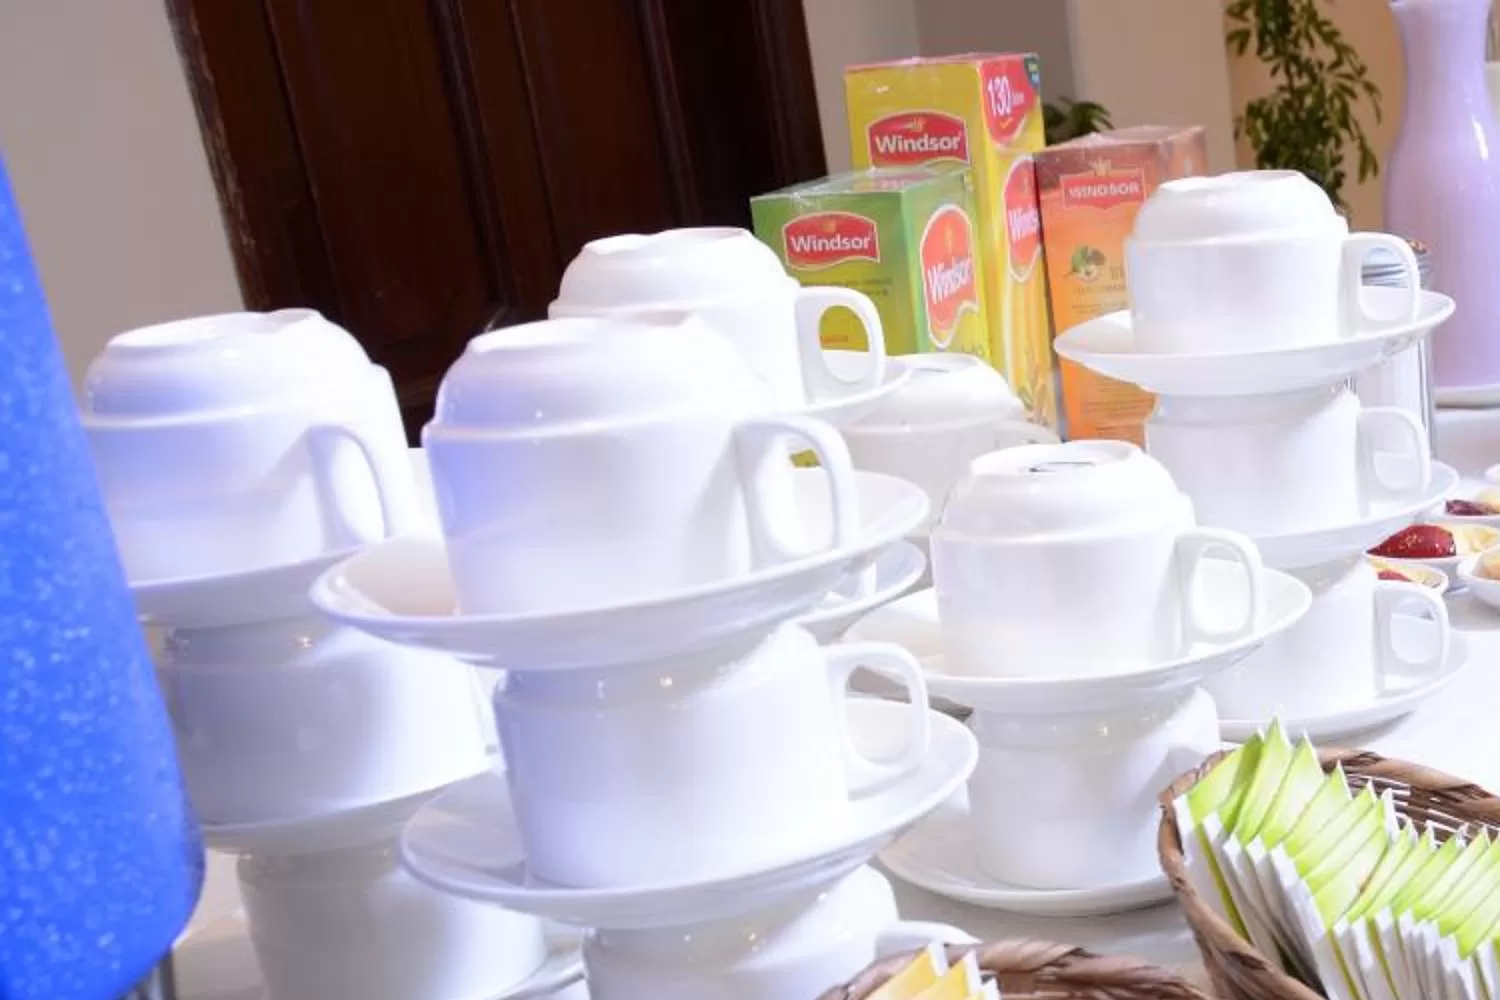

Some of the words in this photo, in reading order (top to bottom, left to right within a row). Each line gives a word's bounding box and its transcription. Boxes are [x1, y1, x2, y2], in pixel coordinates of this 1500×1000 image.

[875, 133, 961, 153] Windsor
[1008, 203, 1039, 242] Winds
[789, 234, 872, 253] Windsor
